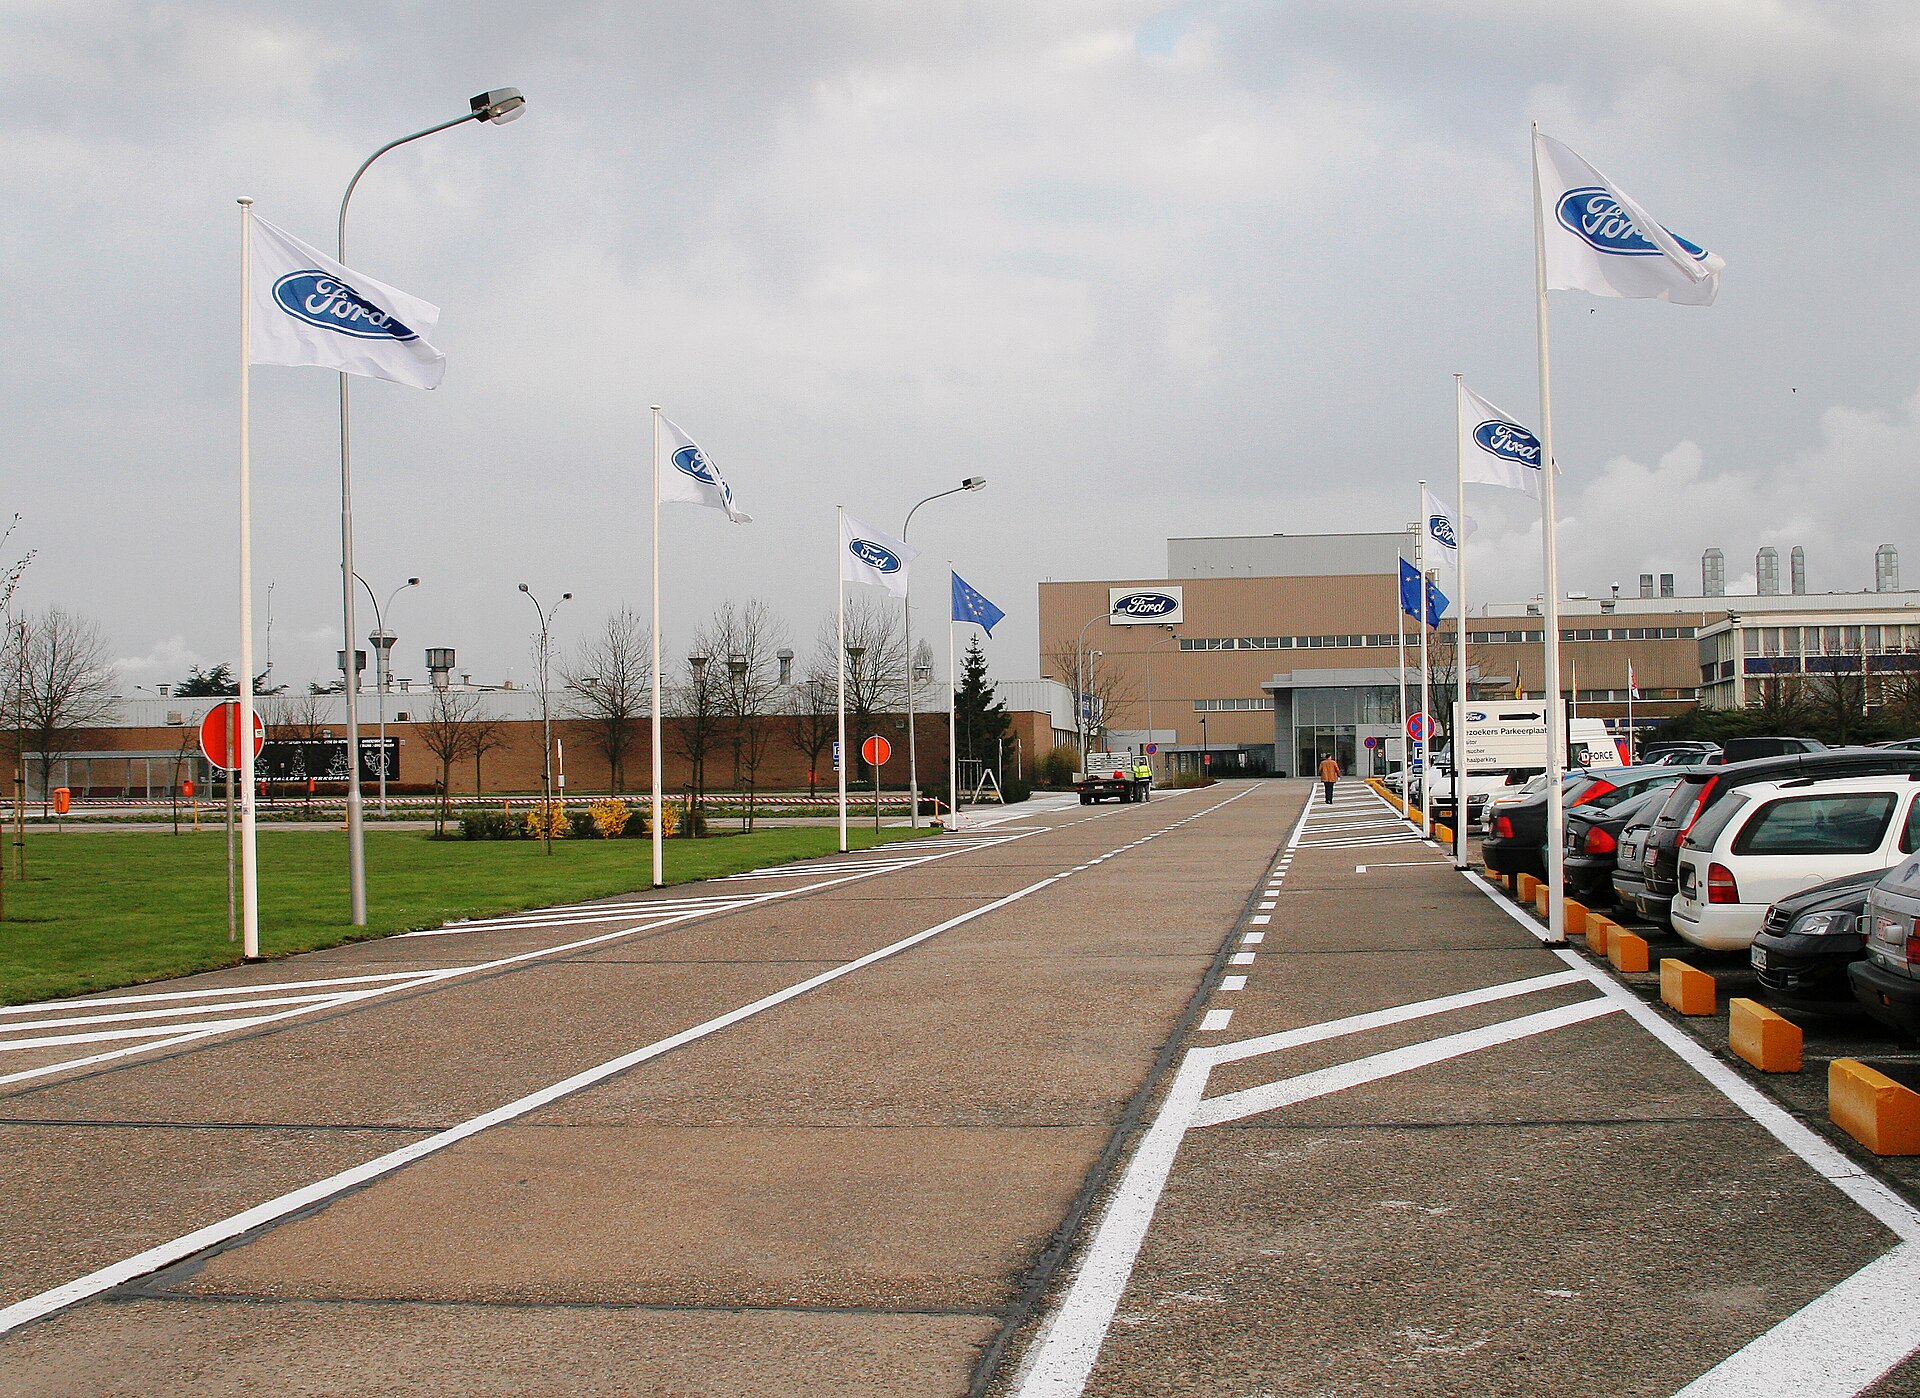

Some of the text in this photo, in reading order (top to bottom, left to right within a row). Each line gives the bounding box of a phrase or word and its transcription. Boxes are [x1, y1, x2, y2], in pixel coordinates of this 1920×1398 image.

[1490, 425, 1541, 460] Ford
[1126, 596, 1166, 613] Ford
[1466, 727, 1547, 736] zoekers Parkeerplaat
[1589, 751, 1614, 760] FORCE
